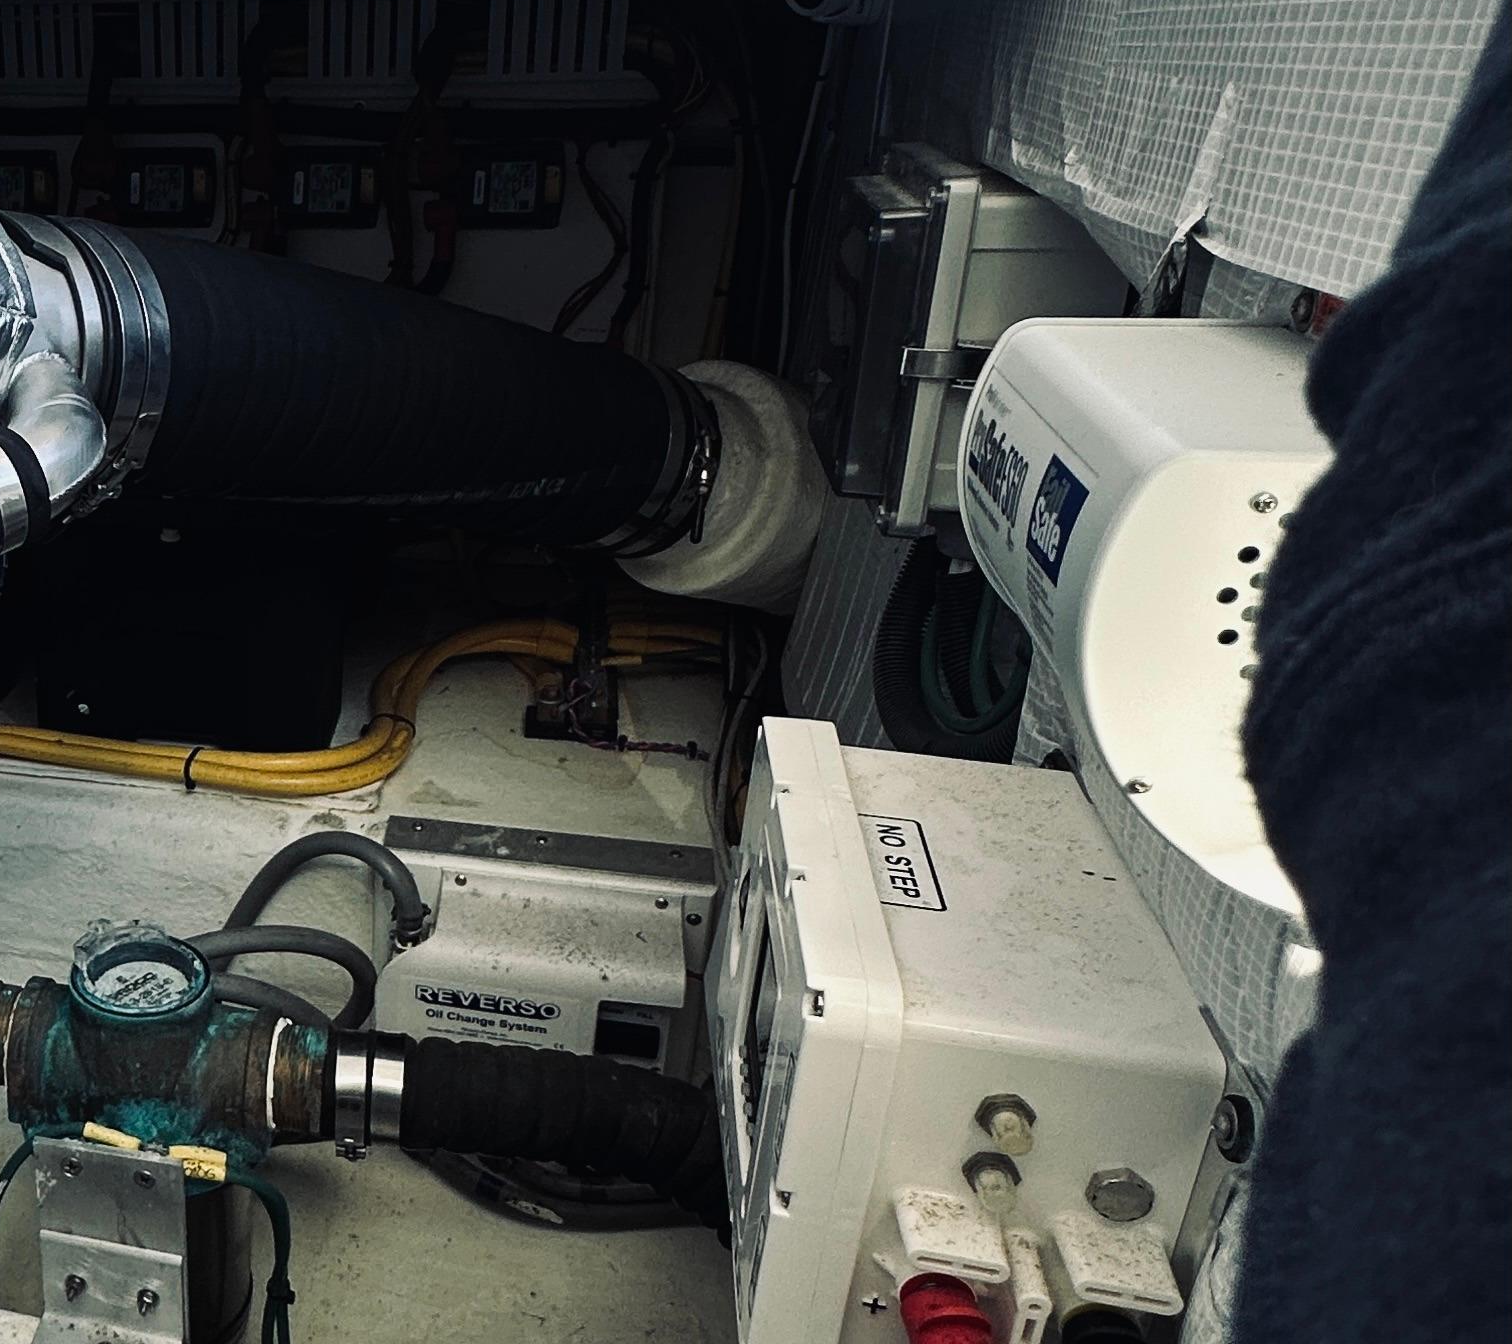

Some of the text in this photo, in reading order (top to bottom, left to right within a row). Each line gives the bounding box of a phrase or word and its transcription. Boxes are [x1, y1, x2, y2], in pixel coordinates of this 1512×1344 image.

[1031, 496, 1061, 562] Safe
[875, 823, 921, 899] NO STEP
[415, 984, 561, 1020] REVERSO
[426, 1008, 443, 1018] Oil
[447, 1011, 496, 1028] Change
[499, 1019, 548, 1035] System
